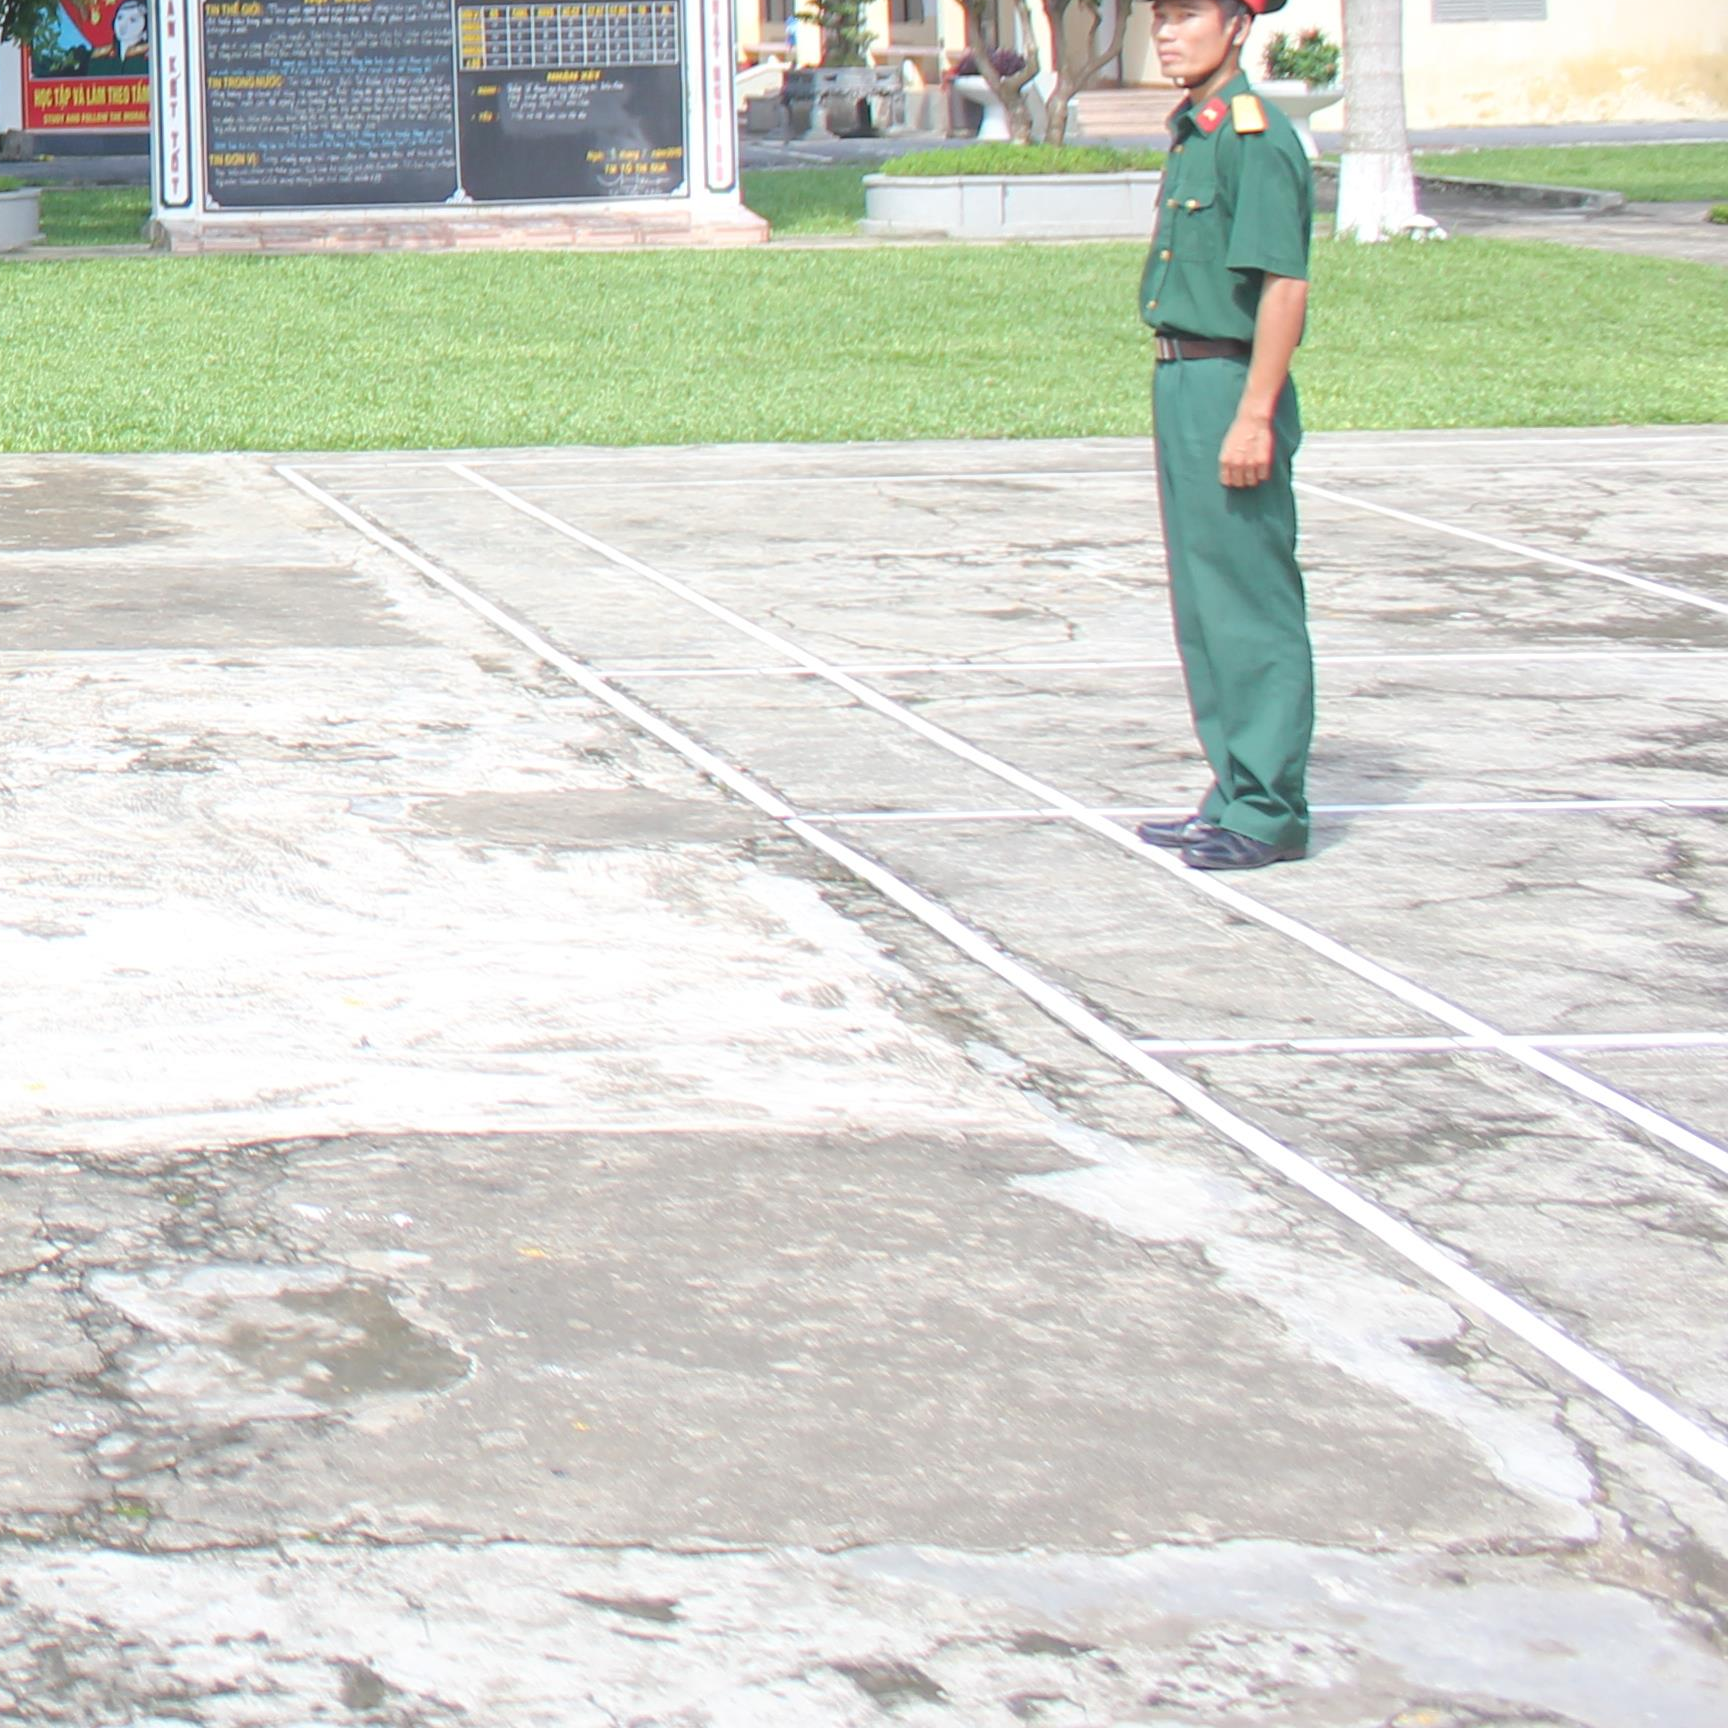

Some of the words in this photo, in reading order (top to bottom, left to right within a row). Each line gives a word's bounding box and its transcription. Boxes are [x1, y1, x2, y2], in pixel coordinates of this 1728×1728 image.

[34, 87, 52, 111] HỌC
[54, 83, 72, 110] TẬP
[72, 83, 85, 106] VÀ
[86, 82, 105, 106] LÀM
[108, 84, 130, 106] THEO
[171, 131, 181, 195] TỐT
